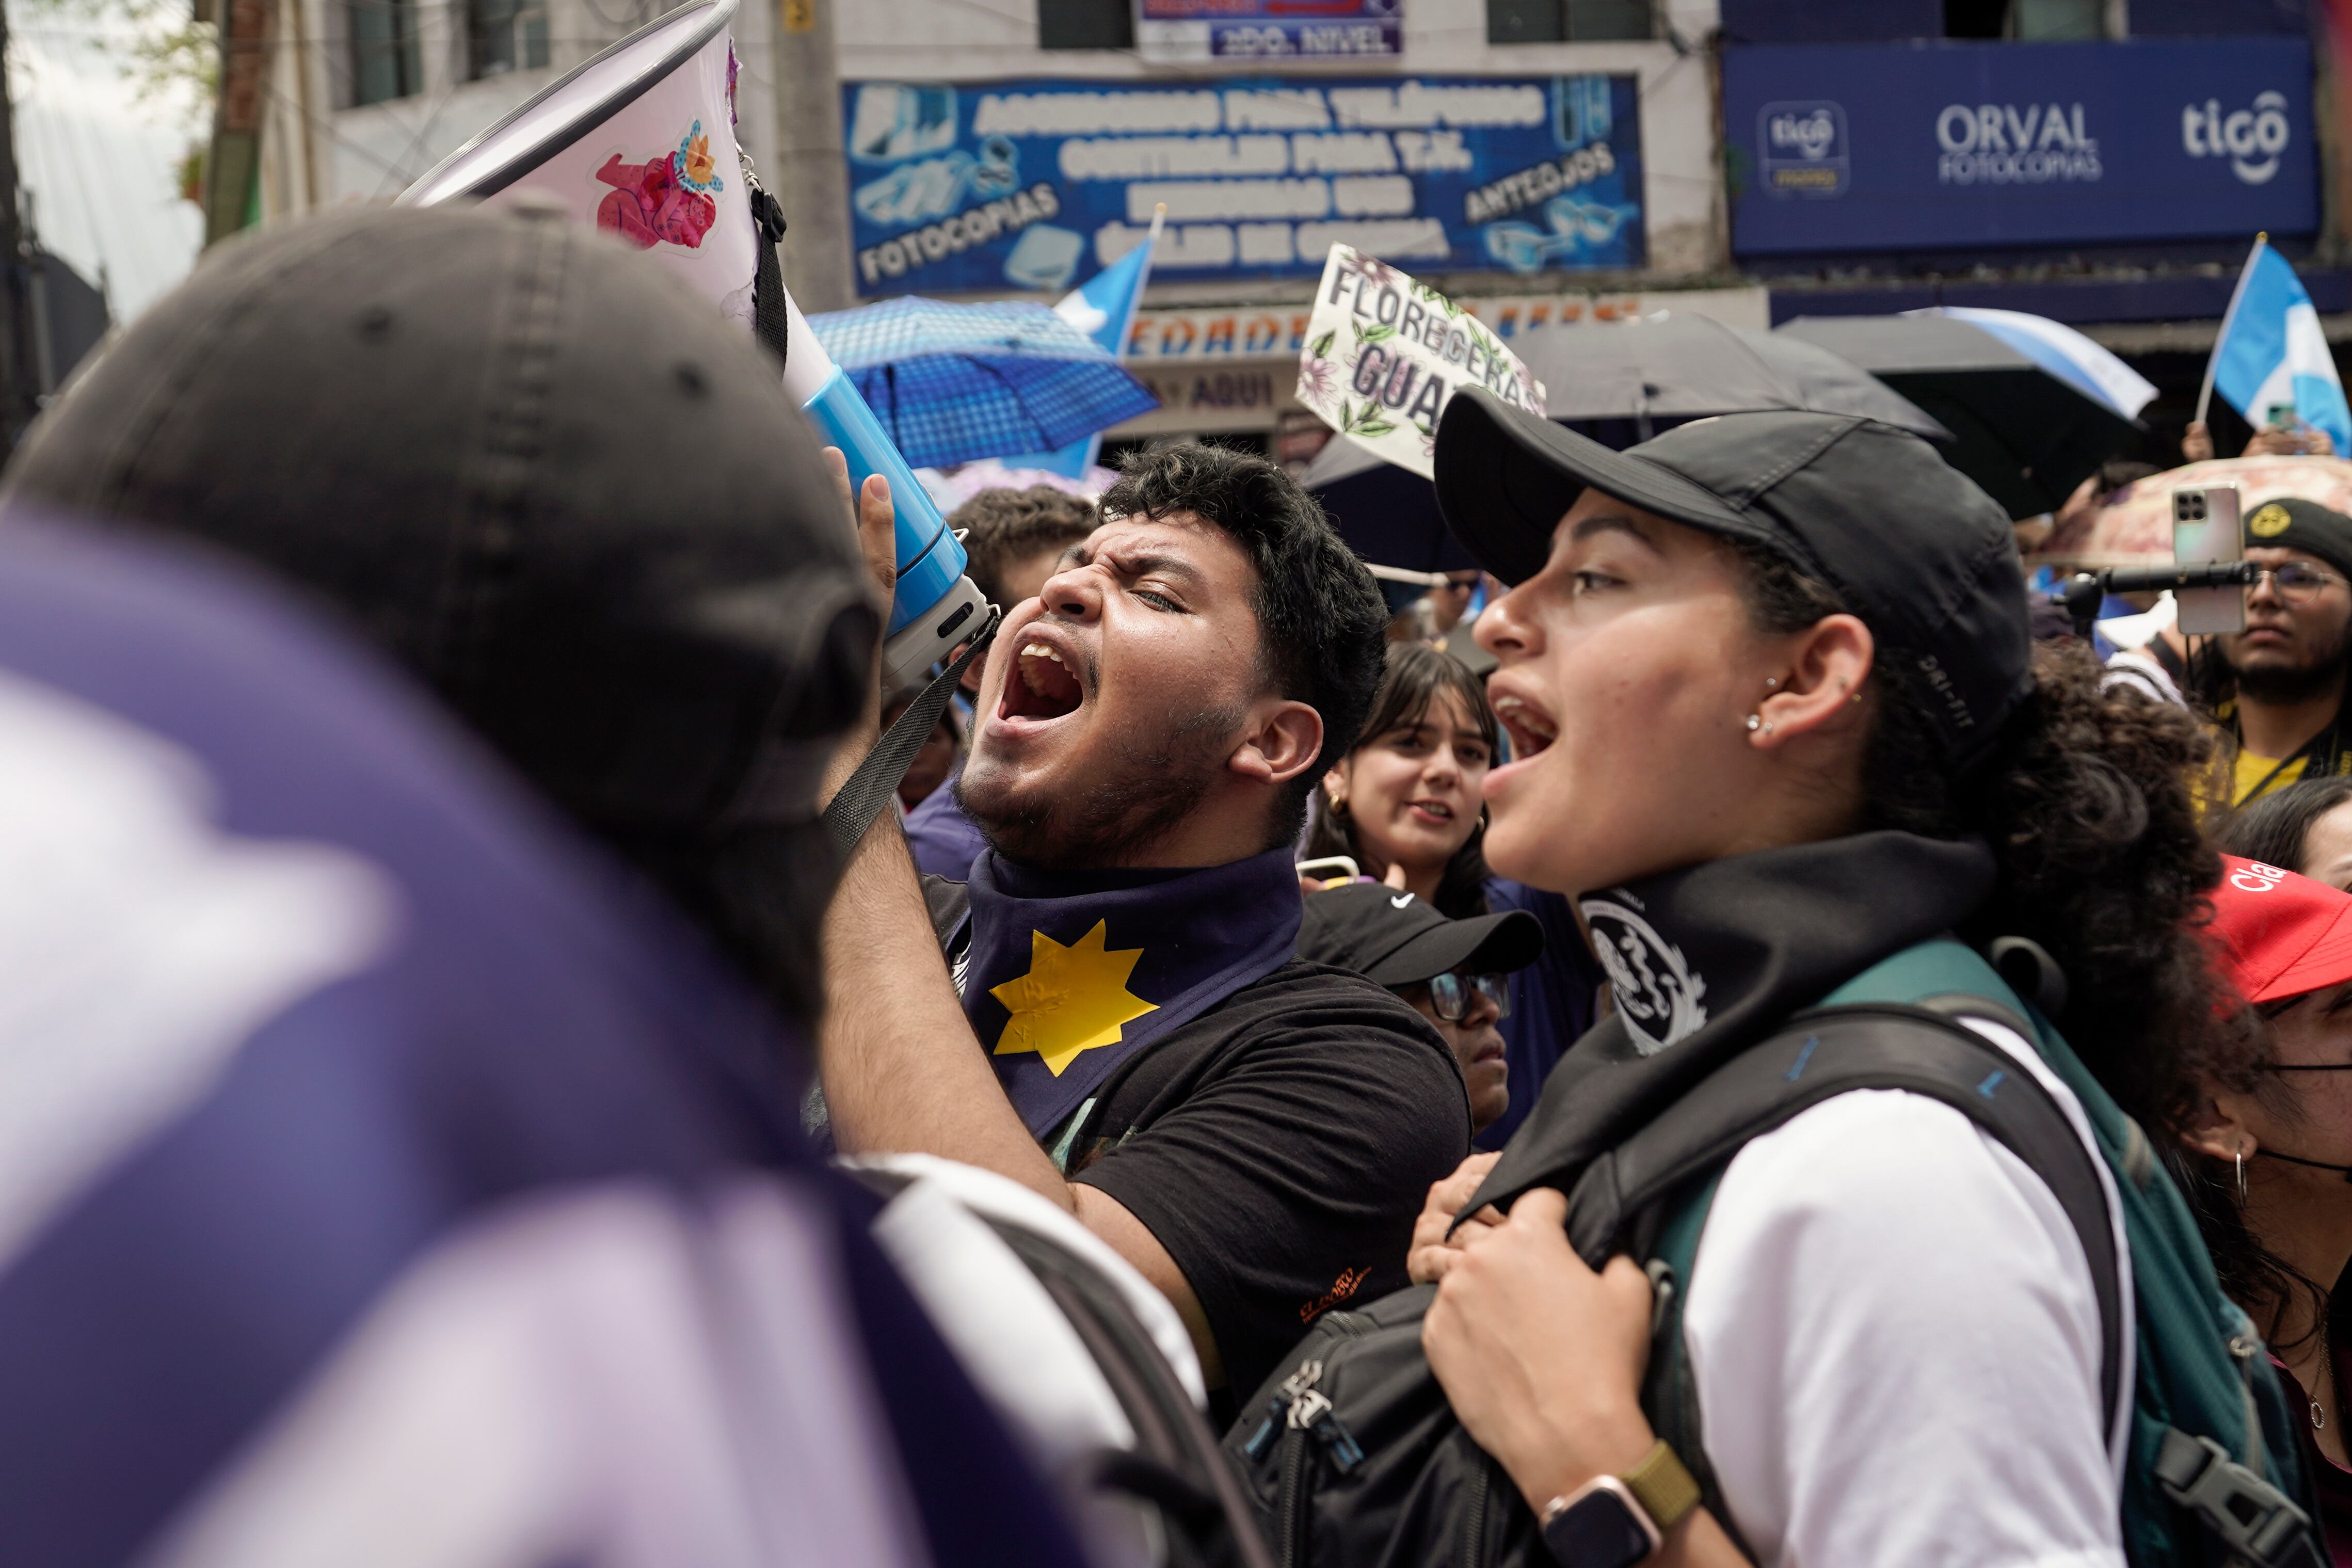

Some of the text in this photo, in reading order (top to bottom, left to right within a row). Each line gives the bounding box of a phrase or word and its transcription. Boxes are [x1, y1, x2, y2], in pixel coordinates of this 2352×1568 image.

[1300, 25, 1391, 52] NIVEL
[1937, 103, 2099, 153] ORVAL
[1465, 141, 1615, 225] ANTEOJOS
[1938, 150, 2103, 185] FOTOCOPIAS
[859, 183, 1060, 285] FOTOCOPIAS
[1351, 342, 1446, 429] GUA
[2230, 861, 2287, 892] Cla
